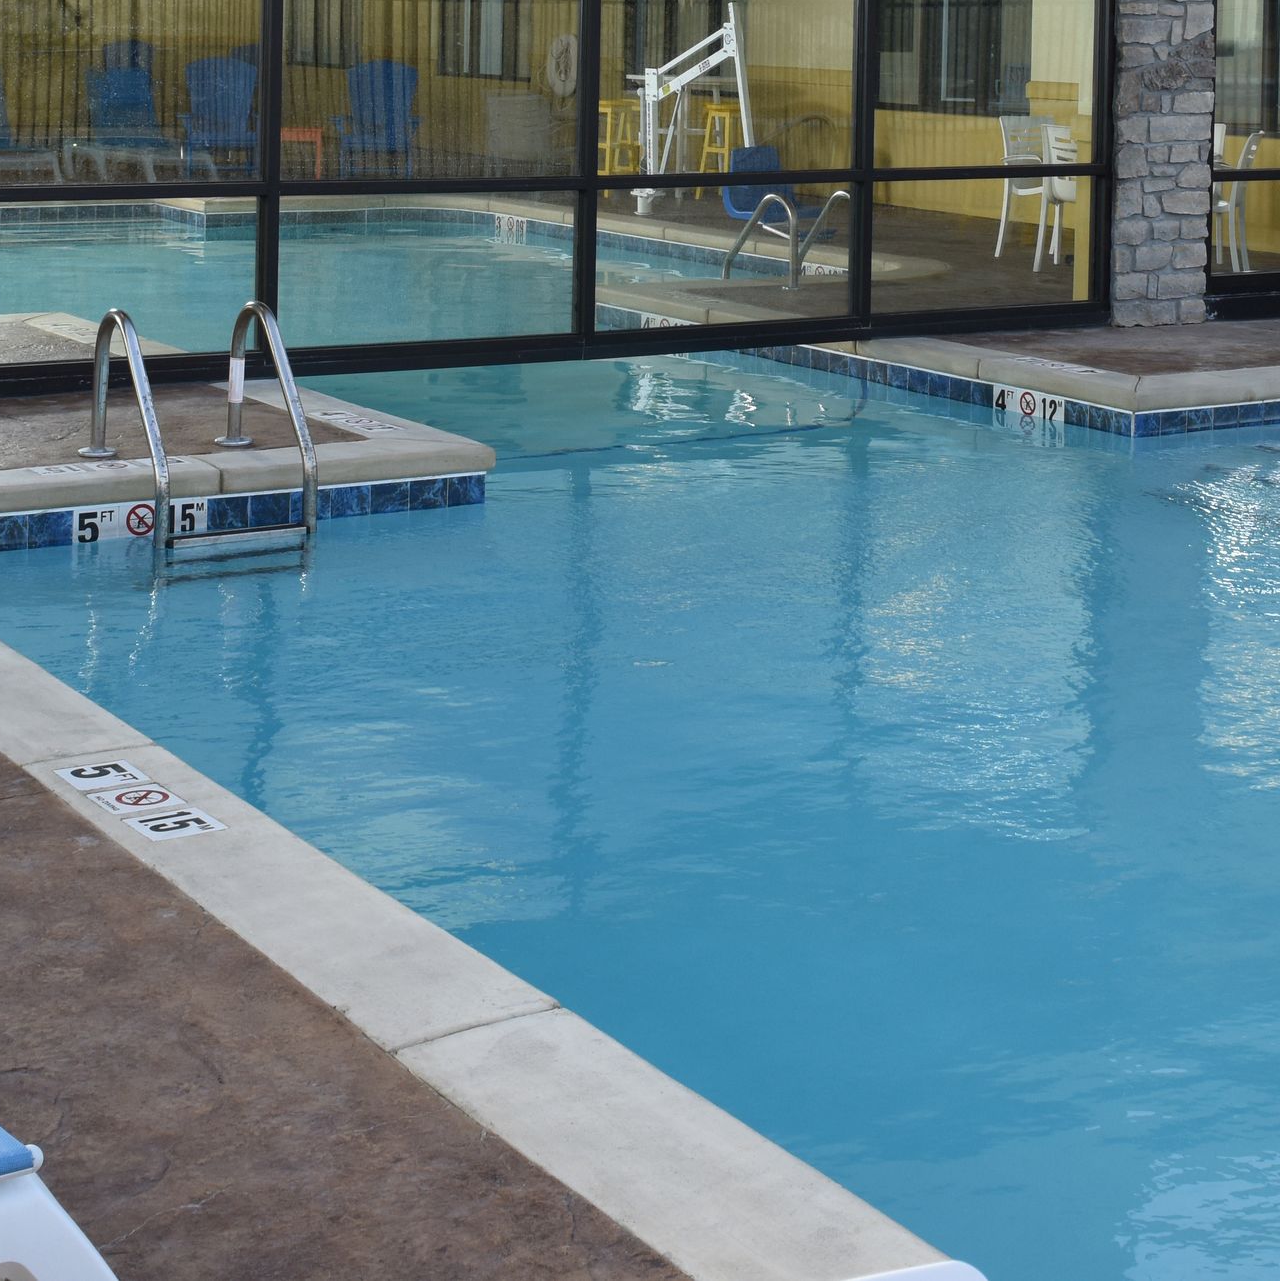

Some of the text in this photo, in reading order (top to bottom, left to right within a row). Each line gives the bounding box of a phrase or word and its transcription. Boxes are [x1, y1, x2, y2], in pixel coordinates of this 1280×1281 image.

[995, 389, 1007, 410] 4
[77, 512, 100, 543] 5
[101, 511, 115, 522] FT
[70, 763, 127, 779] 5
